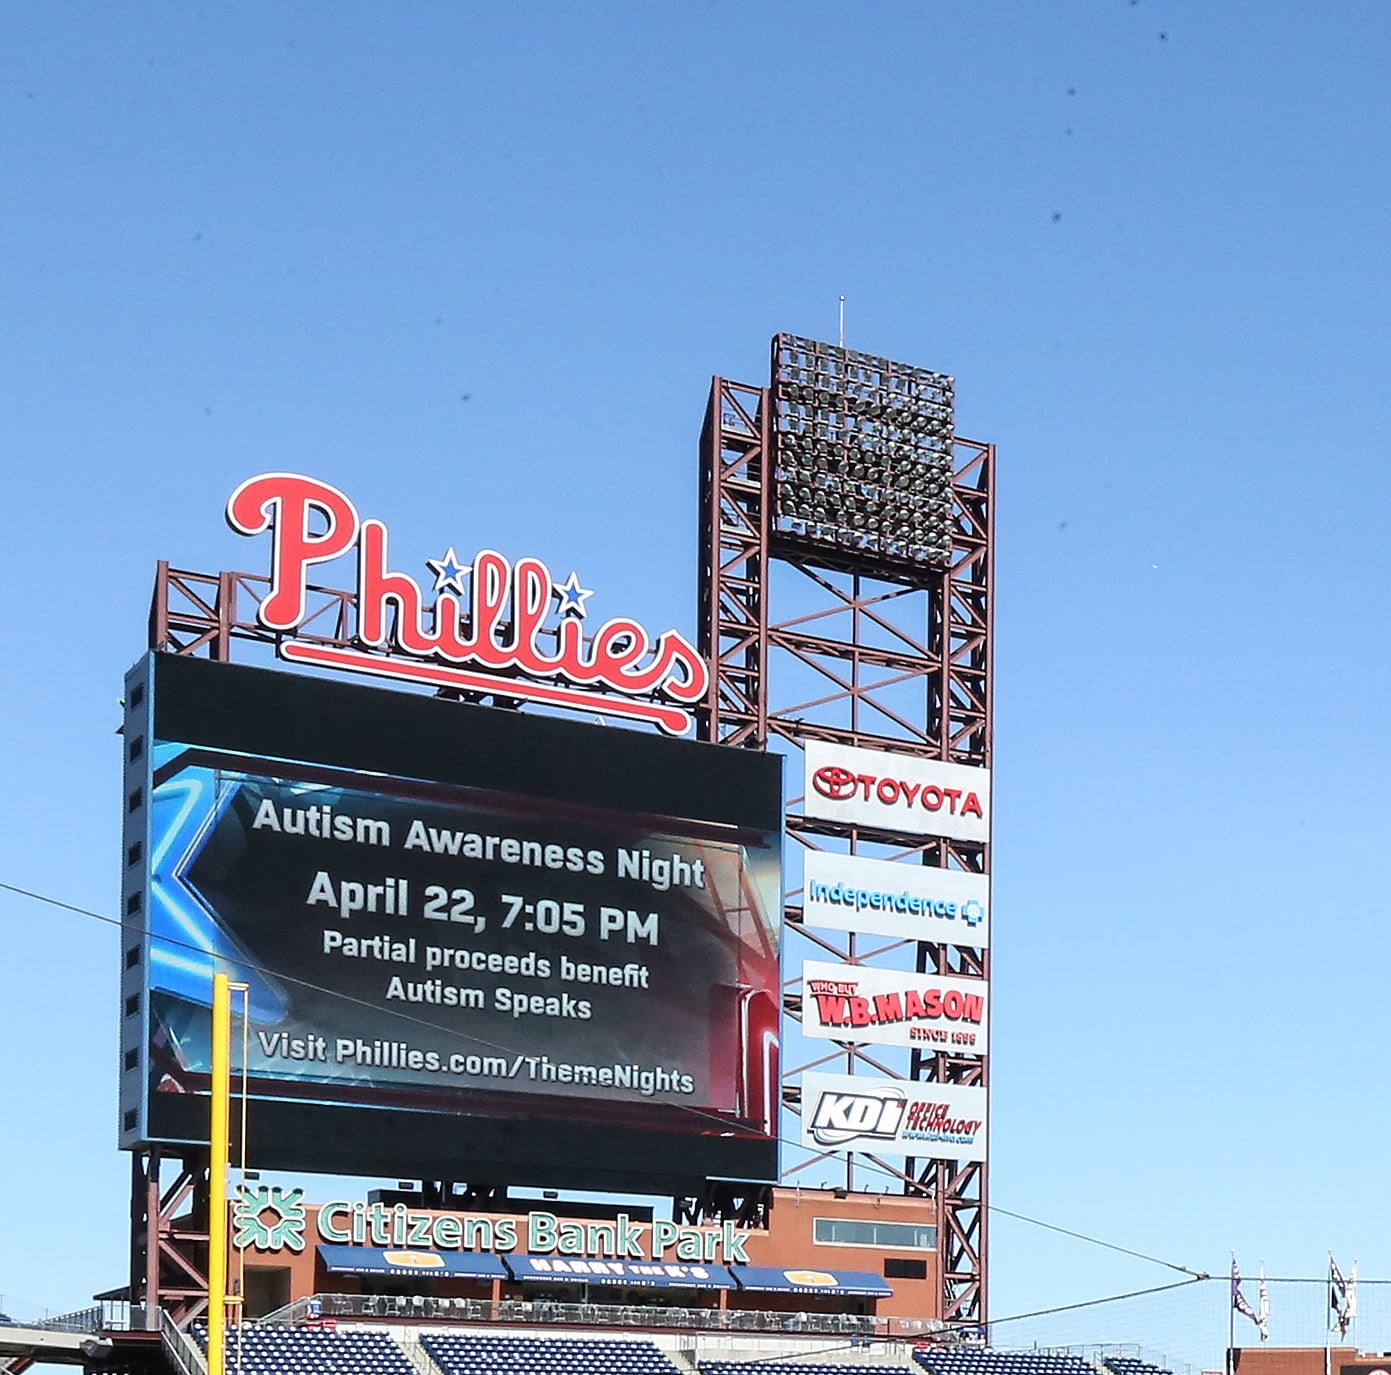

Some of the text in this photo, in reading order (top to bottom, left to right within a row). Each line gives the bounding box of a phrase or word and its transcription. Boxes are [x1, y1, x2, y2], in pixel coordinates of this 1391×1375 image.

[226, 472, 710, 702] Phillies
[857, 774, 984, 818] TOYOTA
[252, 799, 706, 893] Autism Awareness Night
[306, 871, 660, 946] April 22, 7:05 PM
[810, 879, 959, 920] Independence
[322, 930, 651, 990] Partial proceeds benefit
[385, 975, 593, 1020] Autism Speaks
[810, 980, 858, 996] WHO BUT
[817, 988, 985, 1028] W.B.MASON
[909, 1027, 949, 1043] SINCE
[258, 1030, 696, 1097] Visit Phillies.com/ThemeNights
[811, 1092, 908, 1139] KDI
[906, 1115, 983, 1137] TECHNOLOGY
[909, 1101, 950, 1120] OFFICE
[317, 1201, 752, 1263] Citizens Bank Park
